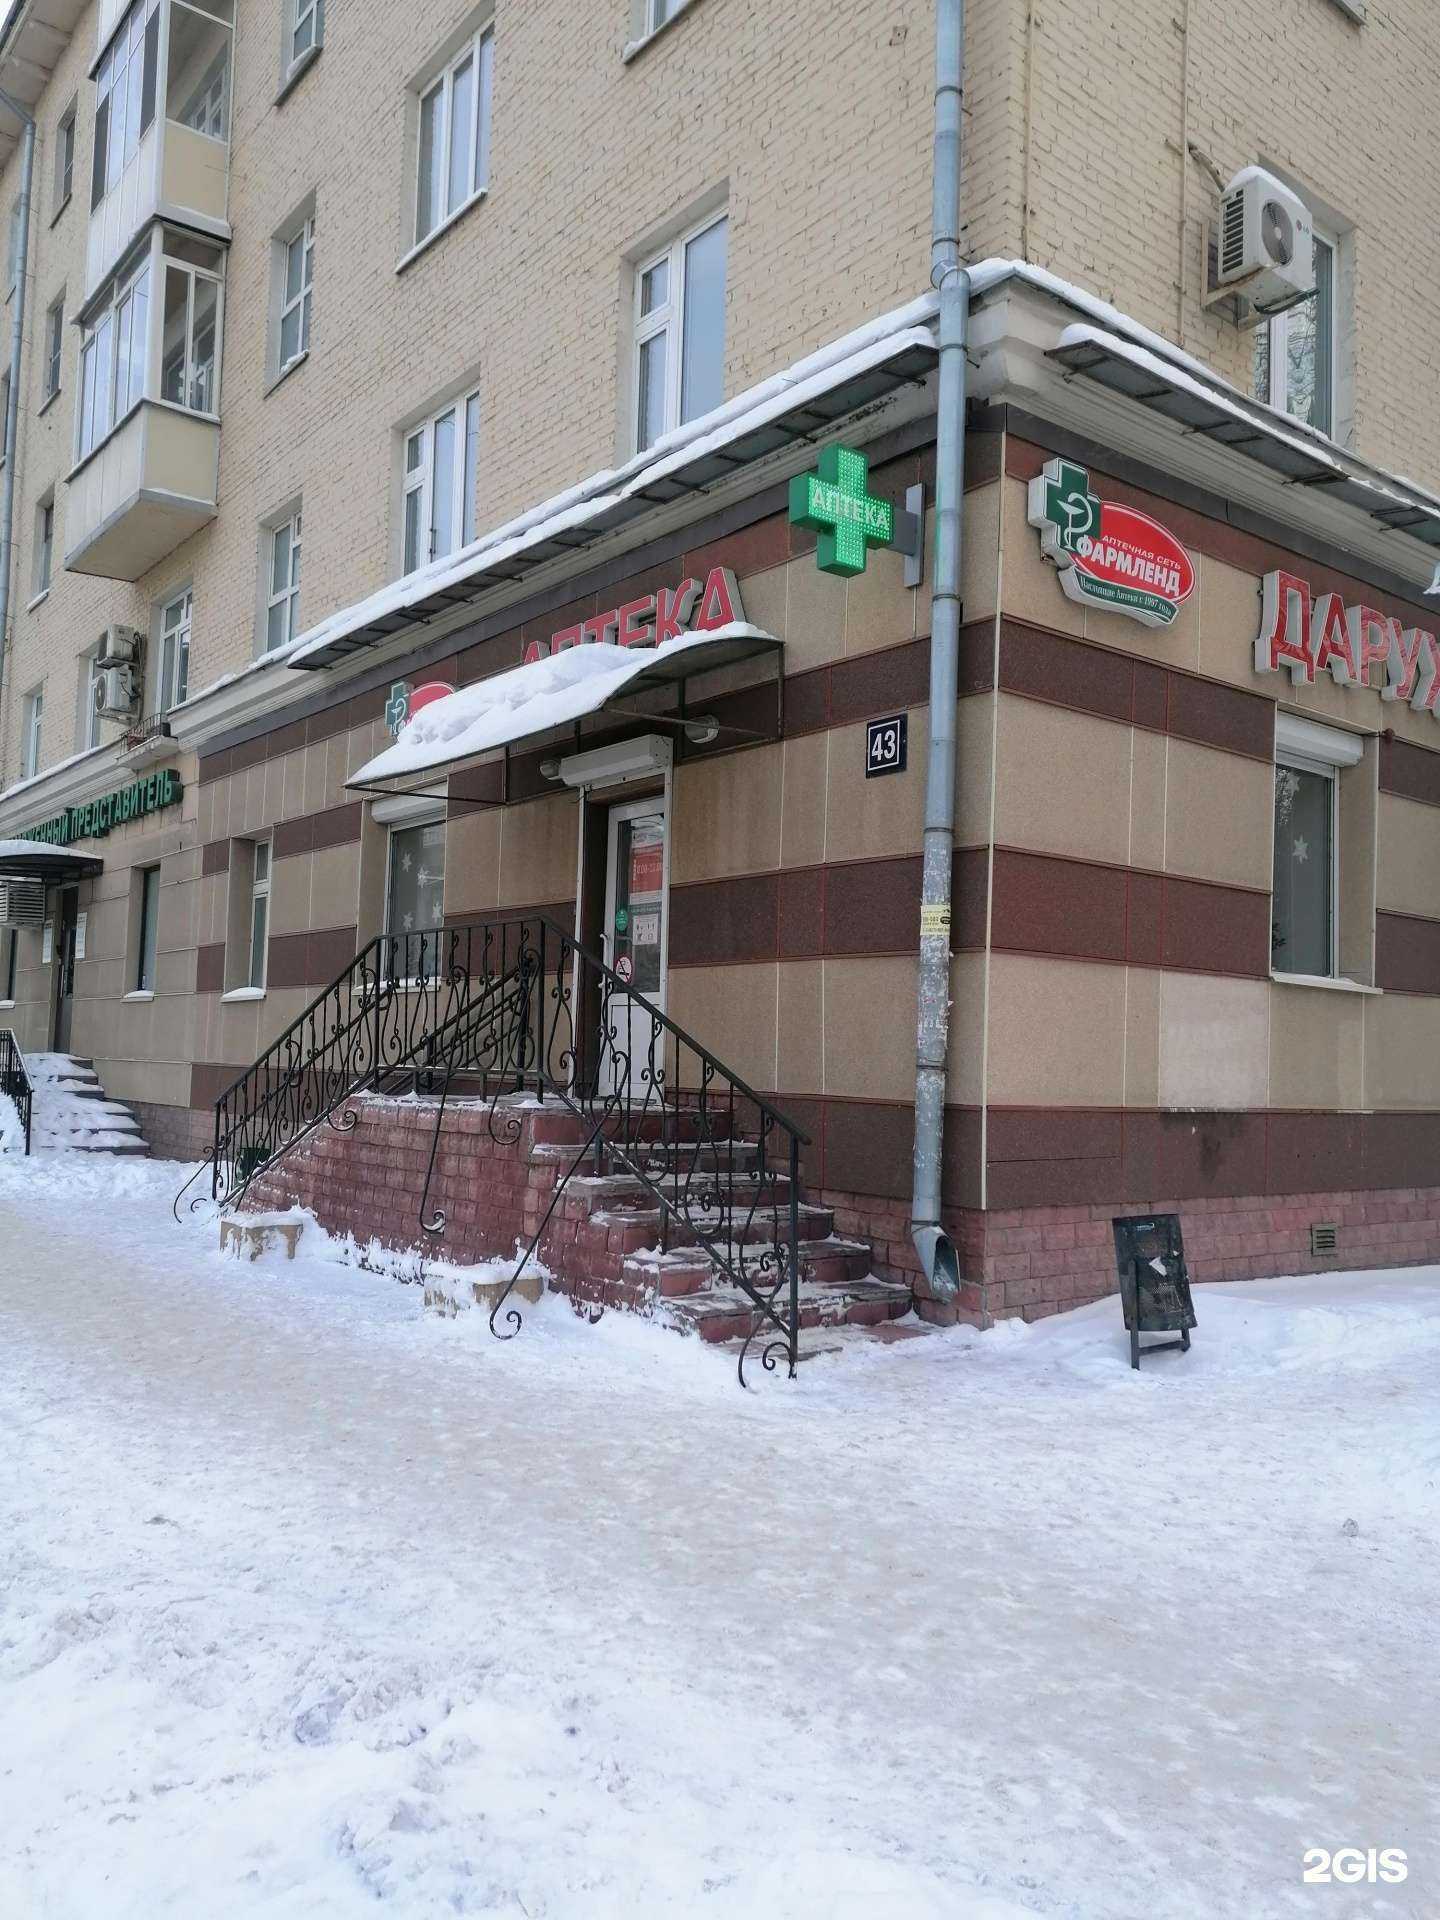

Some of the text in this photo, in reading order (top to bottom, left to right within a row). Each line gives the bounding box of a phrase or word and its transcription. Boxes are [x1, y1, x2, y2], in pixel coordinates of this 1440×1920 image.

[812, 484, 889, 531] АПТЕКА
[1076, 535, 1181, 597] ФАРМЛЕНД
[1102, 535, 1181, 570] АПТЕЧНАЯ СЕТЬ
[871, 729, 897, 761] 43
[71, 770, 176, 838] ПРЕДСТАВИТЕЛЬ
